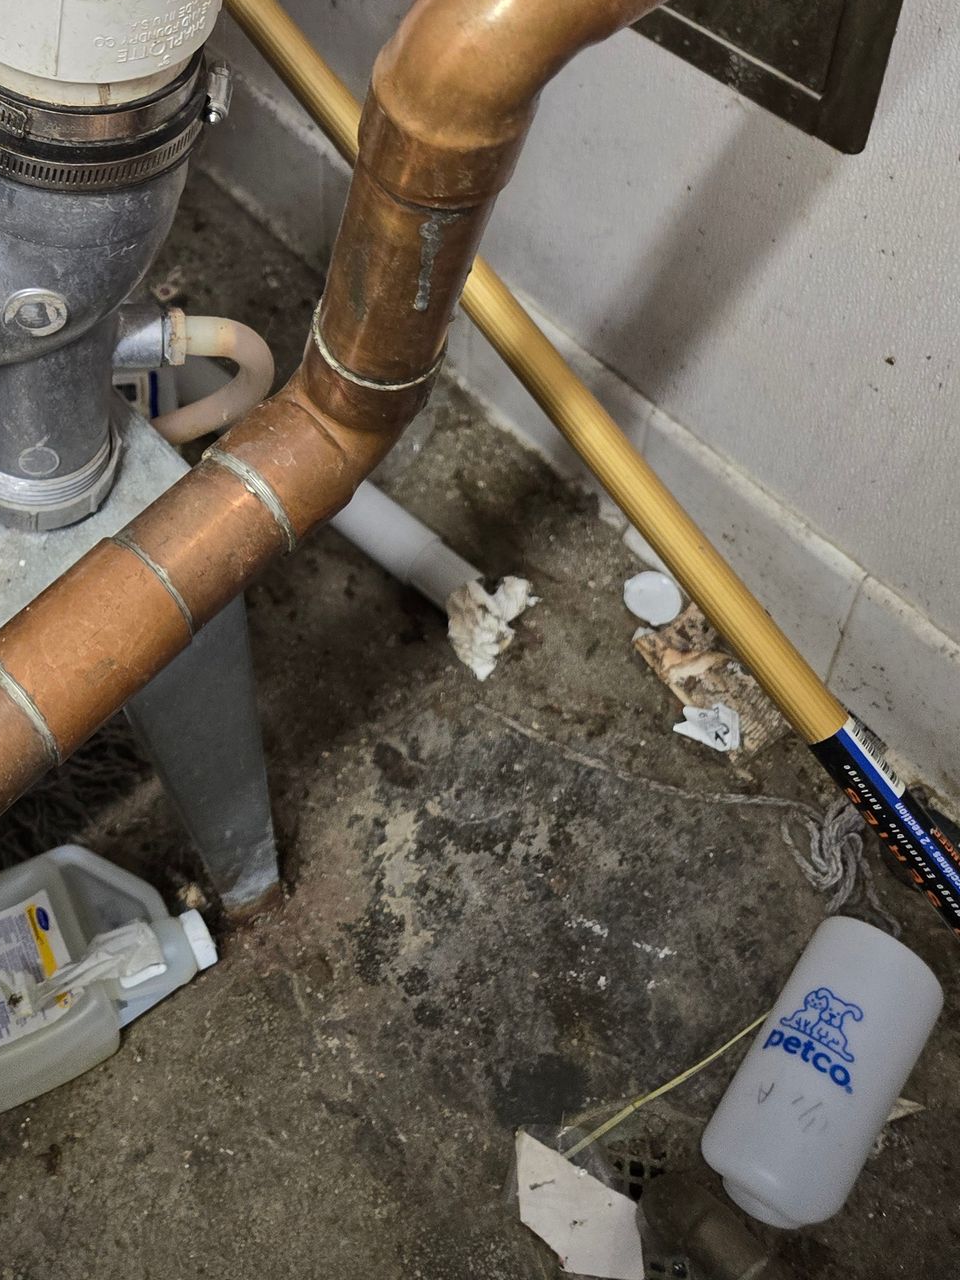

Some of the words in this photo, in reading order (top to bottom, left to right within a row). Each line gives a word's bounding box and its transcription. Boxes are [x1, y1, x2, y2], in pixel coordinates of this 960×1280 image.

[843, 764, 883, 811] Rallonge
[894, 802, 925, 837] section
[762, 1028, 851, 1087] petco
